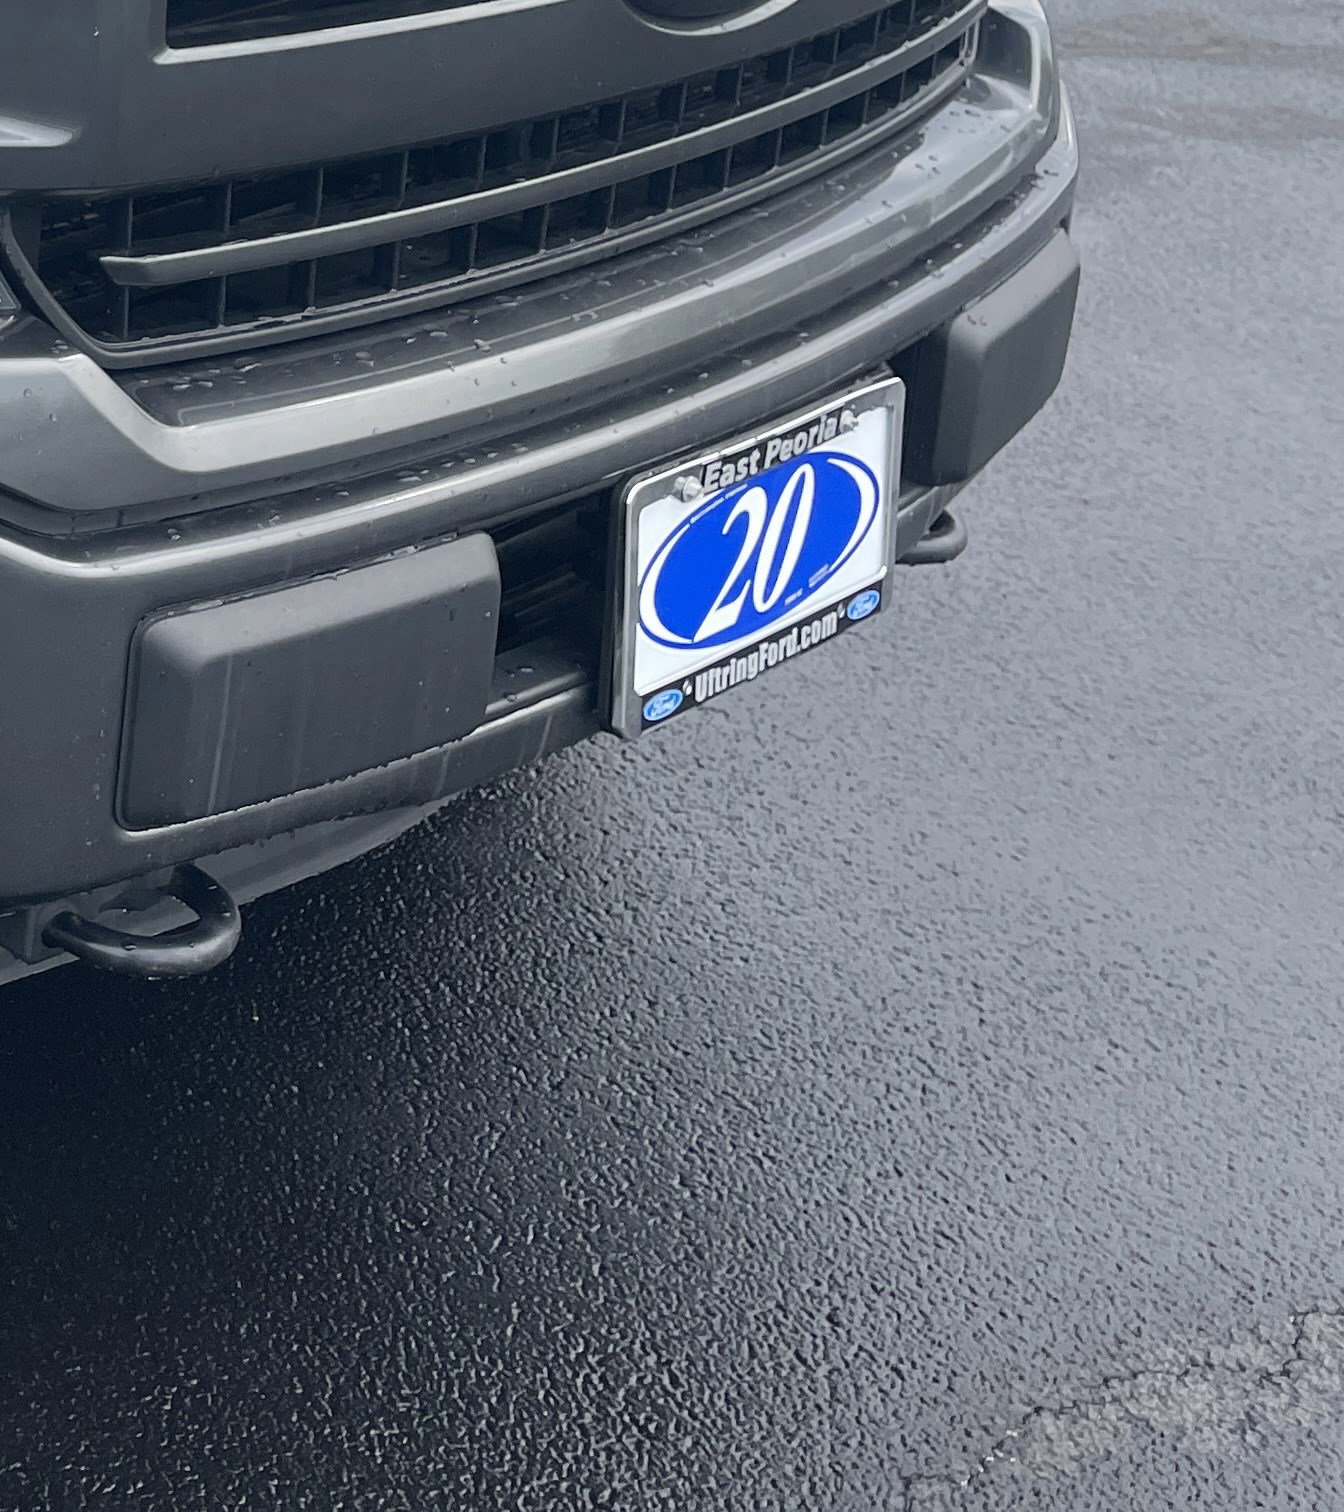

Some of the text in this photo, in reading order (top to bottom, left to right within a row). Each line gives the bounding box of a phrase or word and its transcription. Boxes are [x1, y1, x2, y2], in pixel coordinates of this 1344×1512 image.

[703, 413, 838, 492] East Peoria
[692, 462, 816, 644] 20
